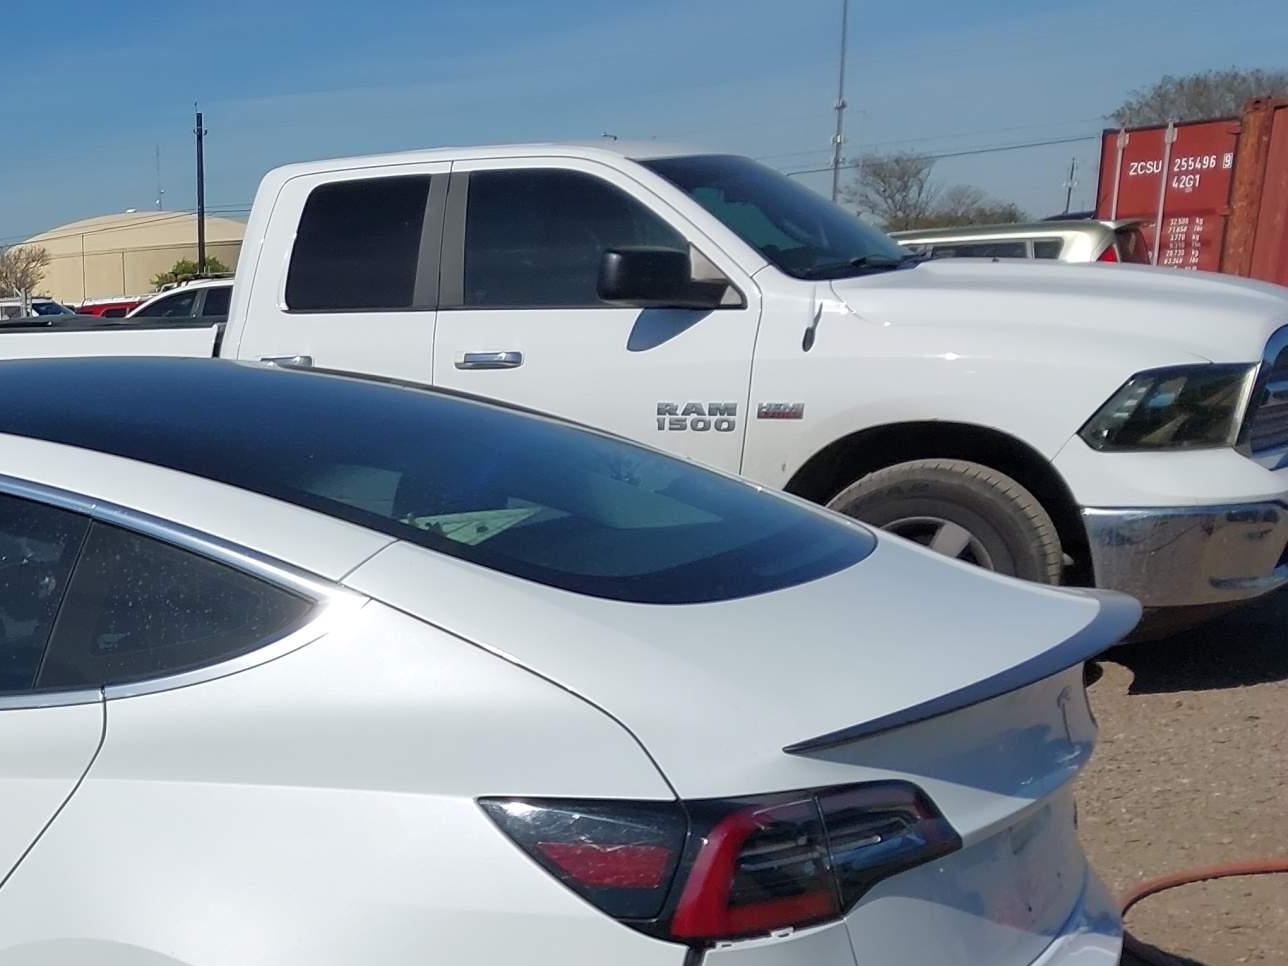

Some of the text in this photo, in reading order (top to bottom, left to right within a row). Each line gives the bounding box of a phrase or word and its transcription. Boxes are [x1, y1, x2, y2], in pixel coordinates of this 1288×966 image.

[1129, 152, 1234, 176] ZCSU 255496 9
[1172, 174, 1200, 188] 42G1
[656, 402, 738, 417] RAM
[656, 417, 736, 432] 1500
